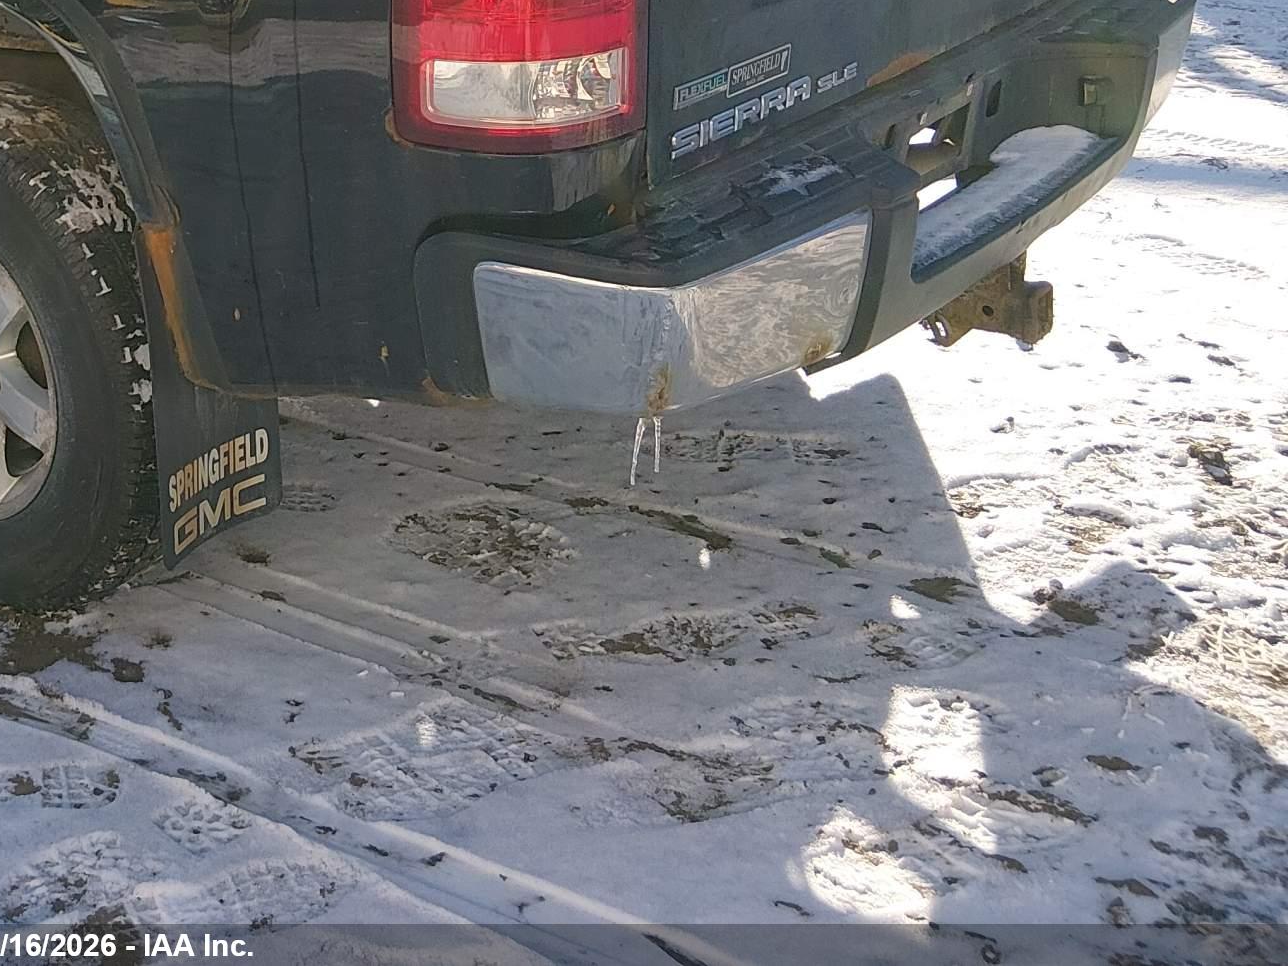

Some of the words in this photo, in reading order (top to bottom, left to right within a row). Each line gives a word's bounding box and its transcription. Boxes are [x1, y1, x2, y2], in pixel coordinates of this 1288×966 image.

[671, 76, 811, 160] SIERRA
[817, 61, 858, 94] SLE
[731, 53, 781, 86] SPRINGFIELD
[169, 428, 269, 512] SPRINGFIELD
[174, 474, 267, 555] GMC
